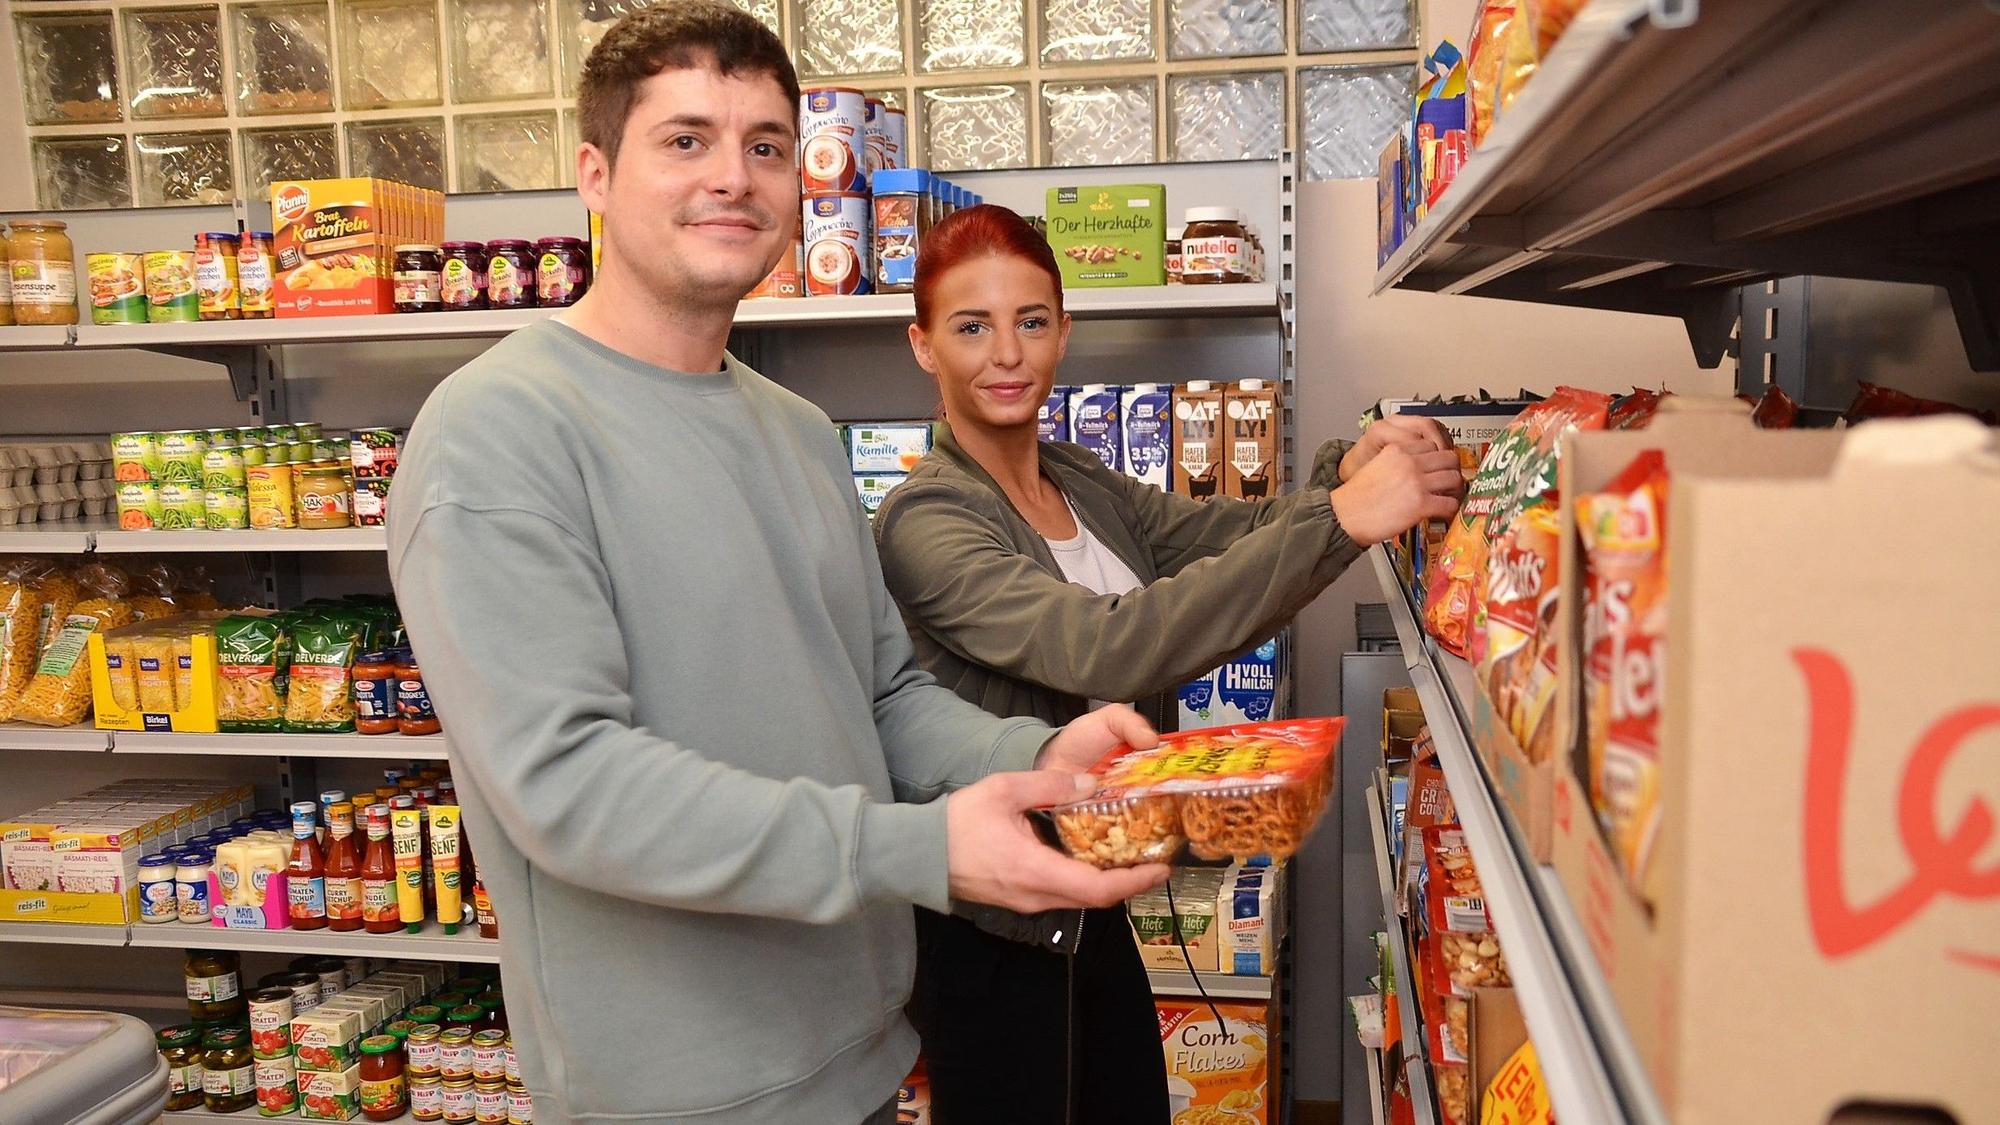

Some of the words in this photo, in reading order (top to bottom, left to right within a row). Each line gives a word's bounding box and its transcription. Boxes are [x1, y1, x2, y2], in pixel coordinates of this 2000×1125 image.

[278, 192, 307, 213] Pfanni
[314, 210, 341, 223] Brat
[291, 216, 369, 242] Kartoffeln
[1052, 216, 1081, 234] Der
[1084, 214, 1152, 233] Herzhafte
[1187, 240, 1237, 255] nutella
[1175, 400, 1221, 420] OAT-
[1227, 399, 1273, 420] OAT-
[1184, 420, 1215, 438] LY!
[1235, 420, 1267, 438] LY!
[1466, 428, 1476, 439] ST
[856, 443, 899, 457] Kamille
[1184, 447, 1204, 455] HAFER
[1236, 446, 1256, 454] HAFER
[1184, 455, 1205, 463] HAVER
[1236, 454, 1256, 463] HAVER
[303, 497, 323, 507] HAK
[860, 492, 884, 505] Kam
[1463, 498, 1494, 513] PAPRIK
[218, 652, 266, 663] DELVERDE
[295, 652, 341, 664] DELVERDE
[1226, 663, 1242, 690] H
[1242, 664, 1273, 678] VOLL
[1242, 678, 1273, 690] MILCH
[145, 715, 169, 724] Birkel
[5, 829, 29, 840] reis-fit
[55, 839, 79, 849] reis-fit
[393, 838, 417, 855] SENF
[431, 839, 456, 856] SENF
[18, 899, 46, 911] reis-fit
[235, 906, 254, 919] MAYO
[1141, 916, 1165, 931] Hefe
[1182, 915, 1205, 931] Hefe
[1228, 917, 1265, 931] Diamant
[1181, 1025, 1240, 1047] Corn
[419, 1045, 438, 1054] HiPP
[477, 1051, 496, 1059] HiPP
[1171, 1050, 1247, 1075] Flakes
[416, 1089, 435, 1098] HiPP
[445, 1093, 463, 1101] HiPP
[483, 1095, 502, 1103] HiPP
